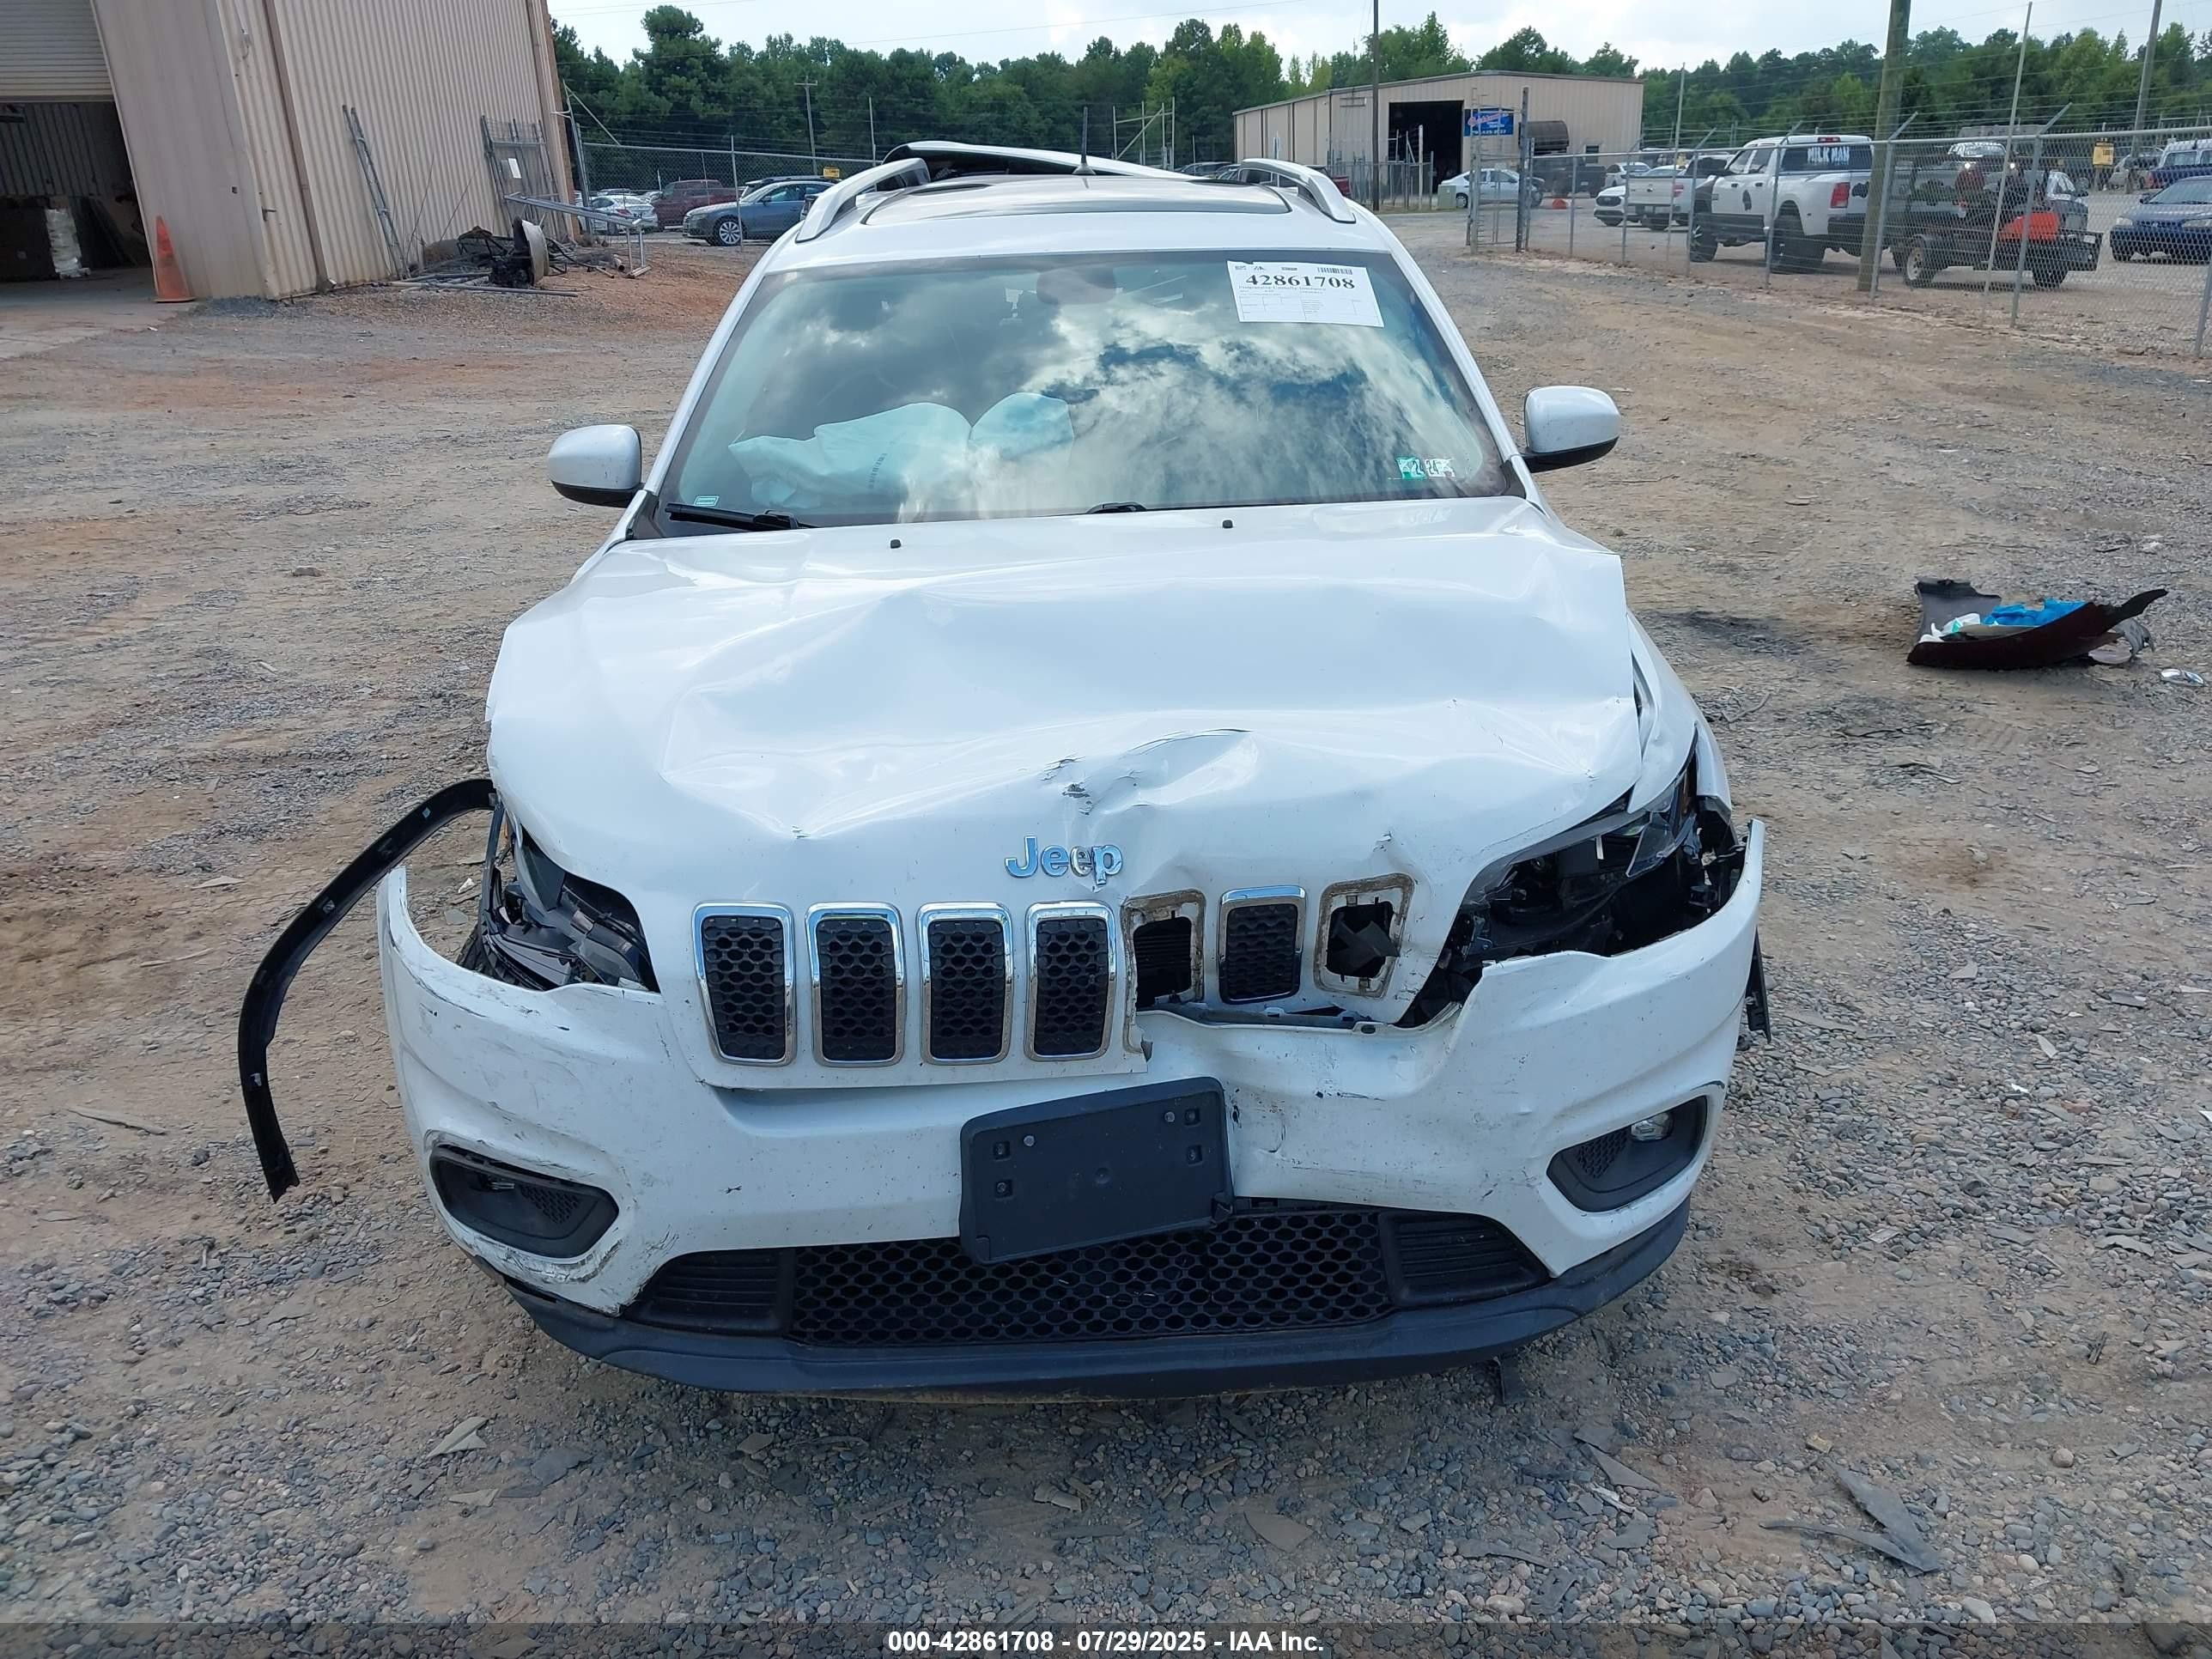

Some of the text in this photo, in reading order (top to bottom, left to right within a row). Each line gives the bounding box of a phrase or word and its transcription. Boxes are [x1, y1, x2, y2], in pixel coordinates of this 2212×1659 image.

[1808, 146, 1850, 163] MILK MAN
[1246, 274, 1355, 289] 42861708
[1004, 835, 1123, 885] Jeep
